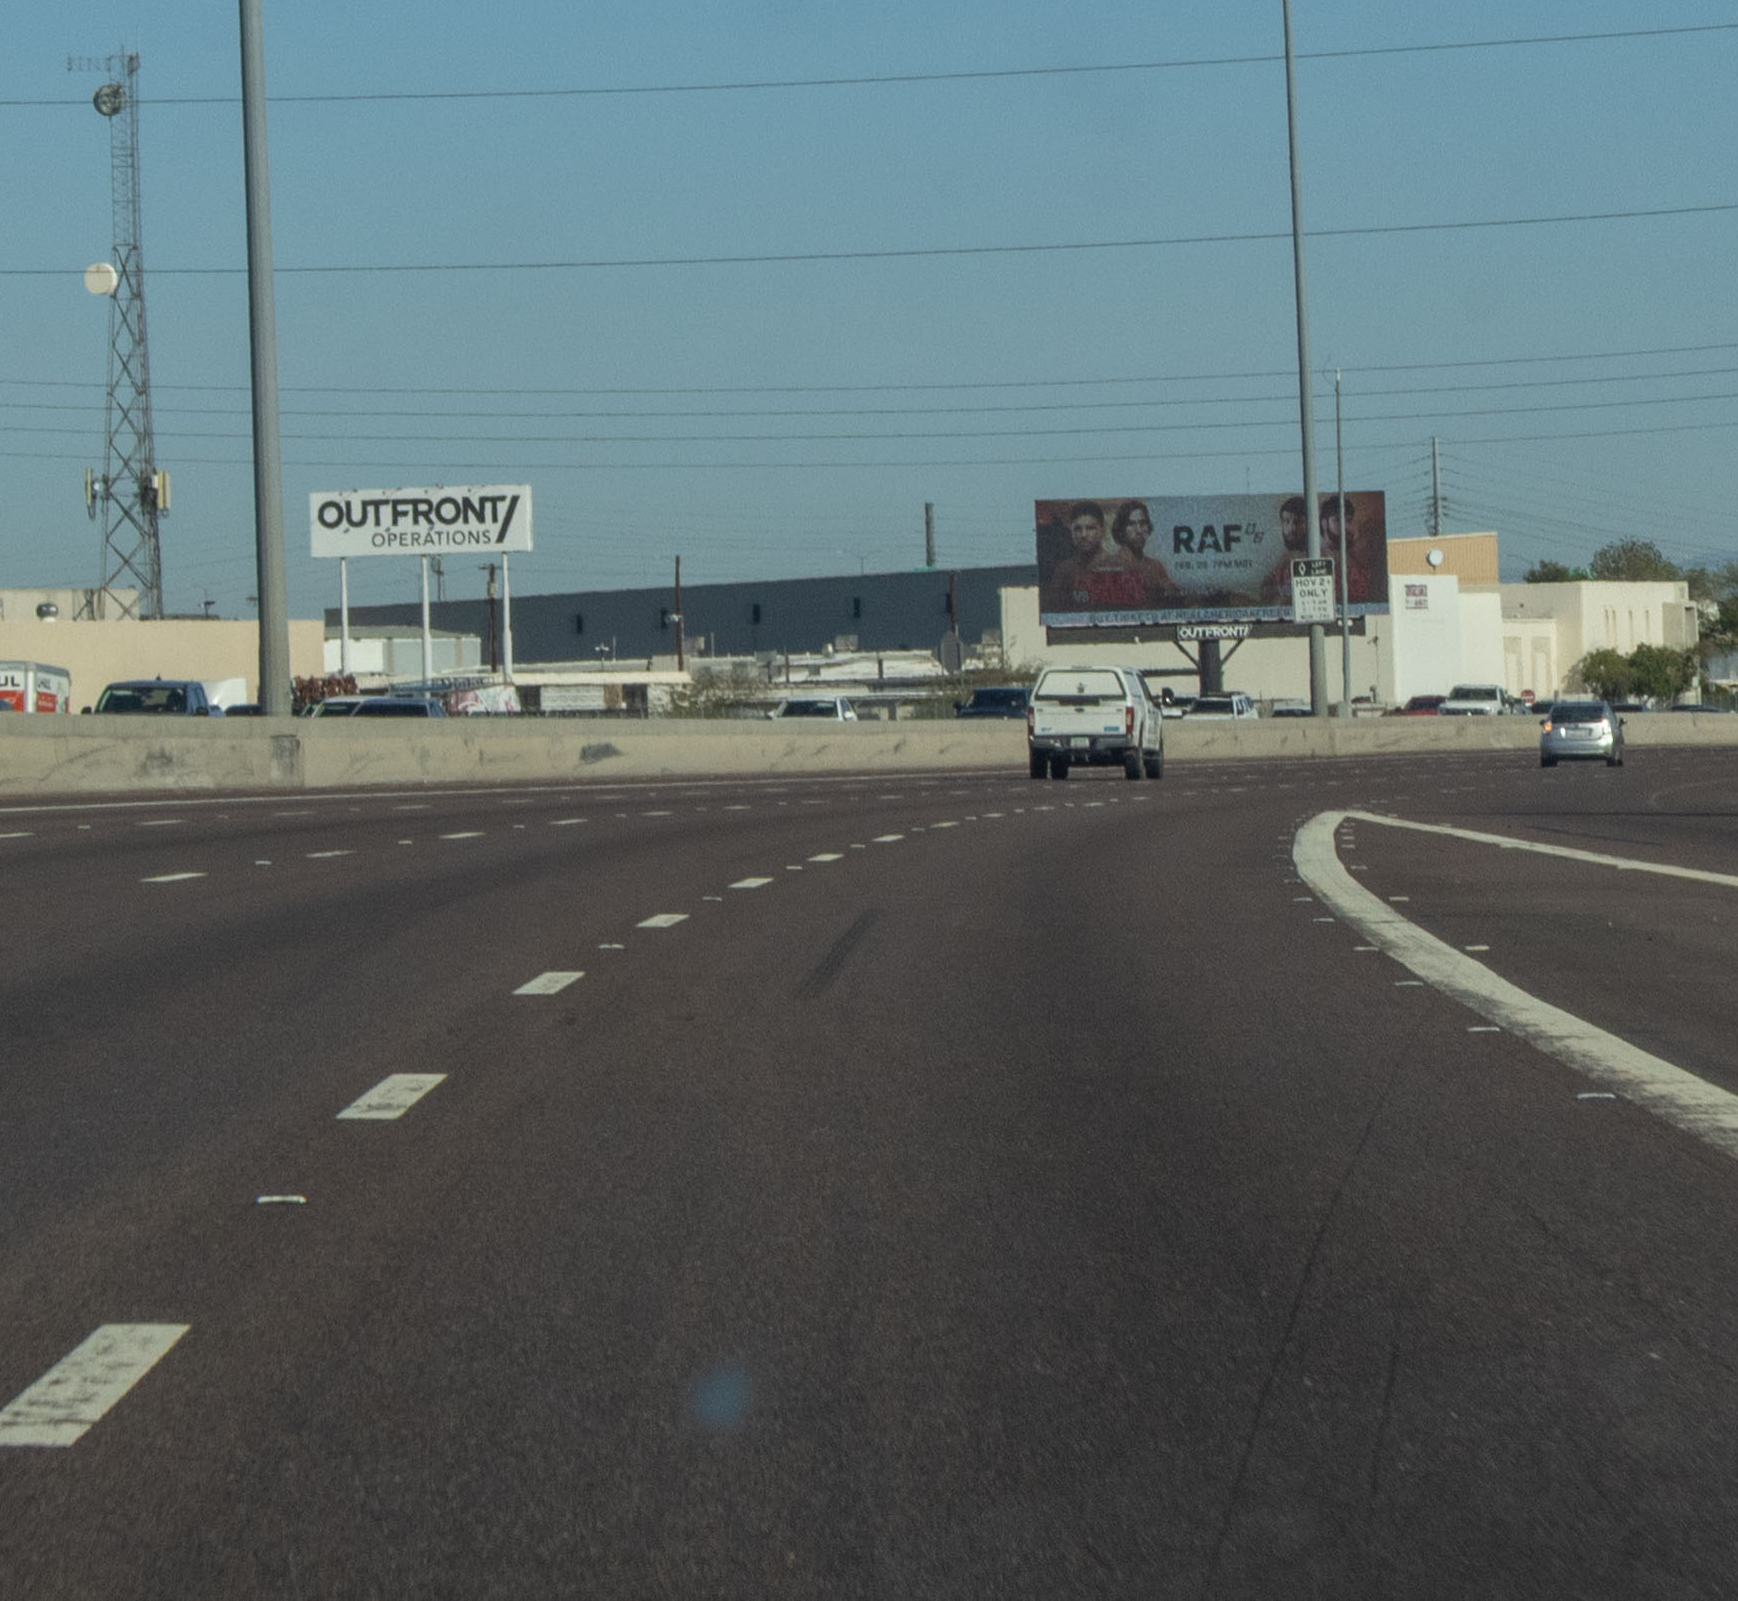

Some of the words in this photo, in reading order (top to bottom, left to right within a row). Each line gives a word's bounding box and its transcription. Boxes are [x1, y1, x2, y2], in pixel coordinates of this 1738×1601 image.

[371, 529, 492, 548] OPERATIONS
[1172, 524, 1242, 554] RAF
[1295, 578, 1316, 587] HOV
[1299, 588, 1328, 598] ONLY
